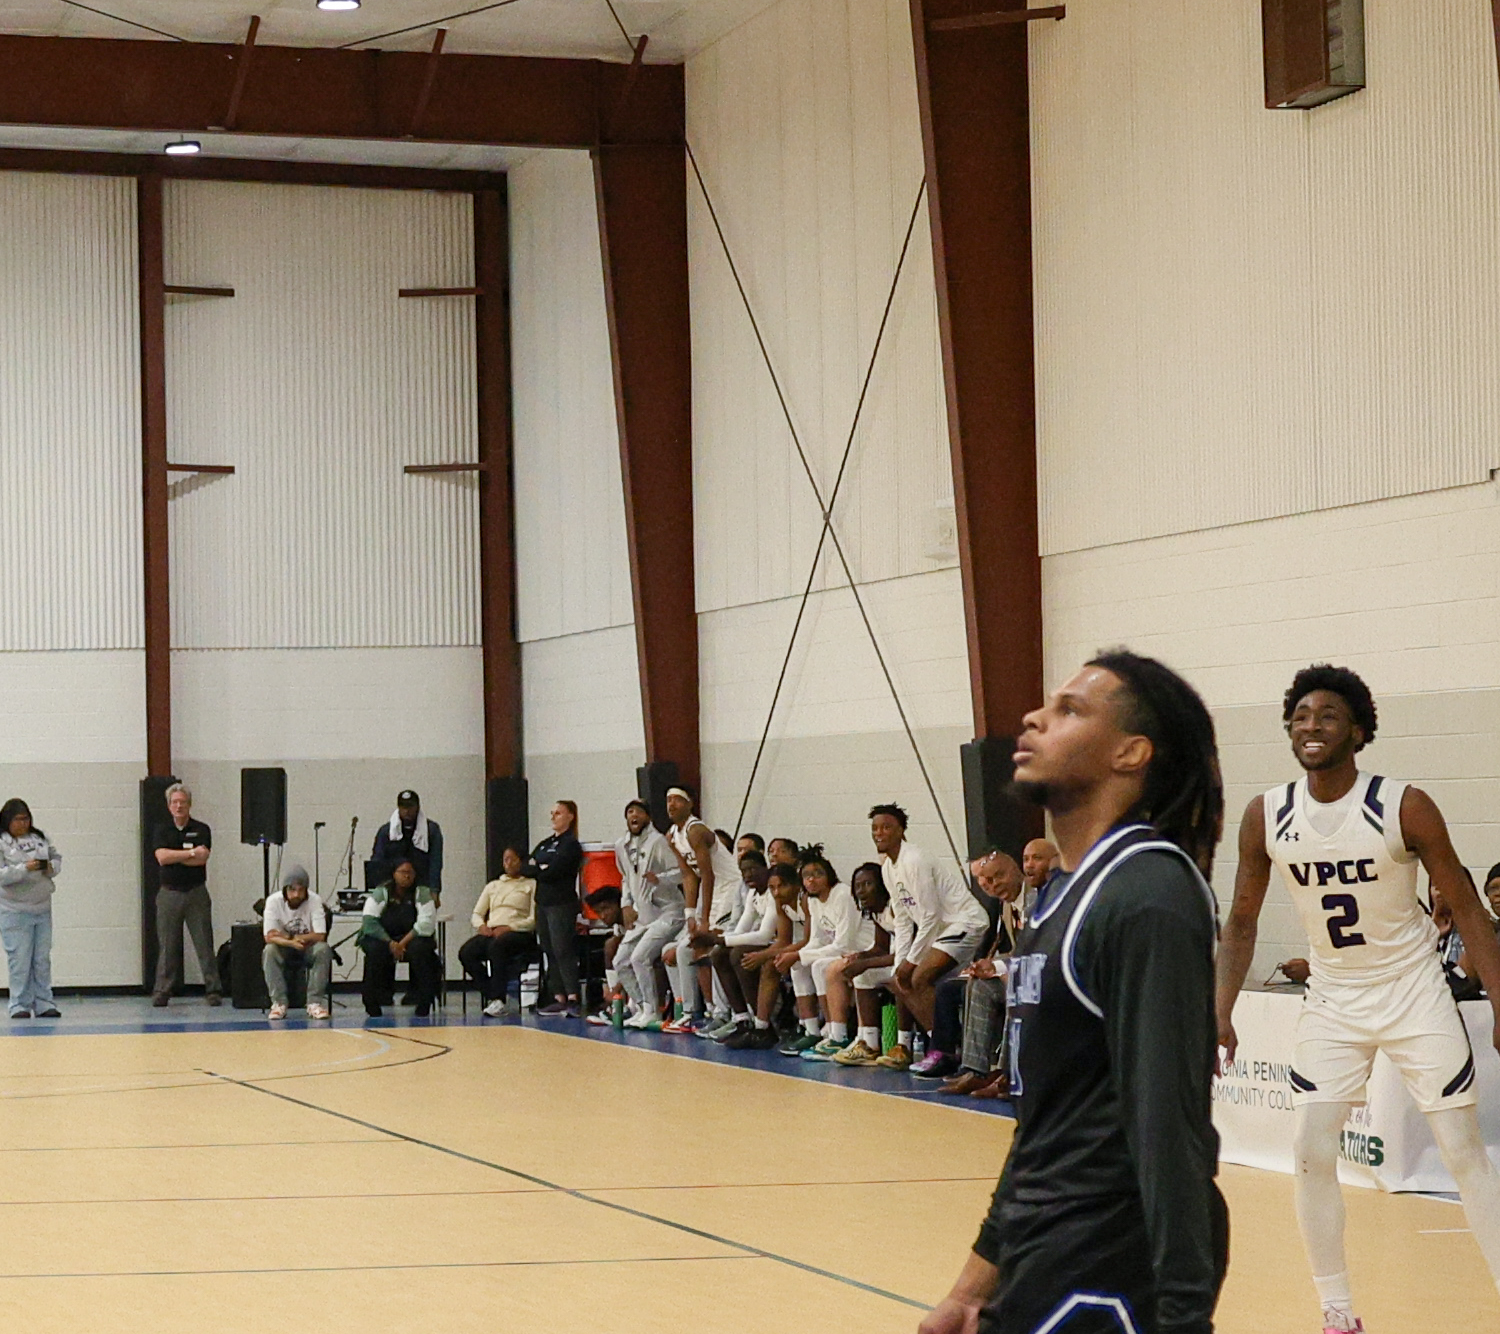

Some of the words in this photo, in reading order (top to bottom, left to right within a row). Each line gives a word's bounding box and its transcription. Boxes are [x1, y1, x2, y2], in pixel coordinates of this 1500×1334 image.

[1288, 858, 1379, 886] VPCC
[1321, 894, 1367, 949] 2
[1268, 1090, 1295, 1112] COLL
[1340, 1129, 1384, 1166] ATORS
